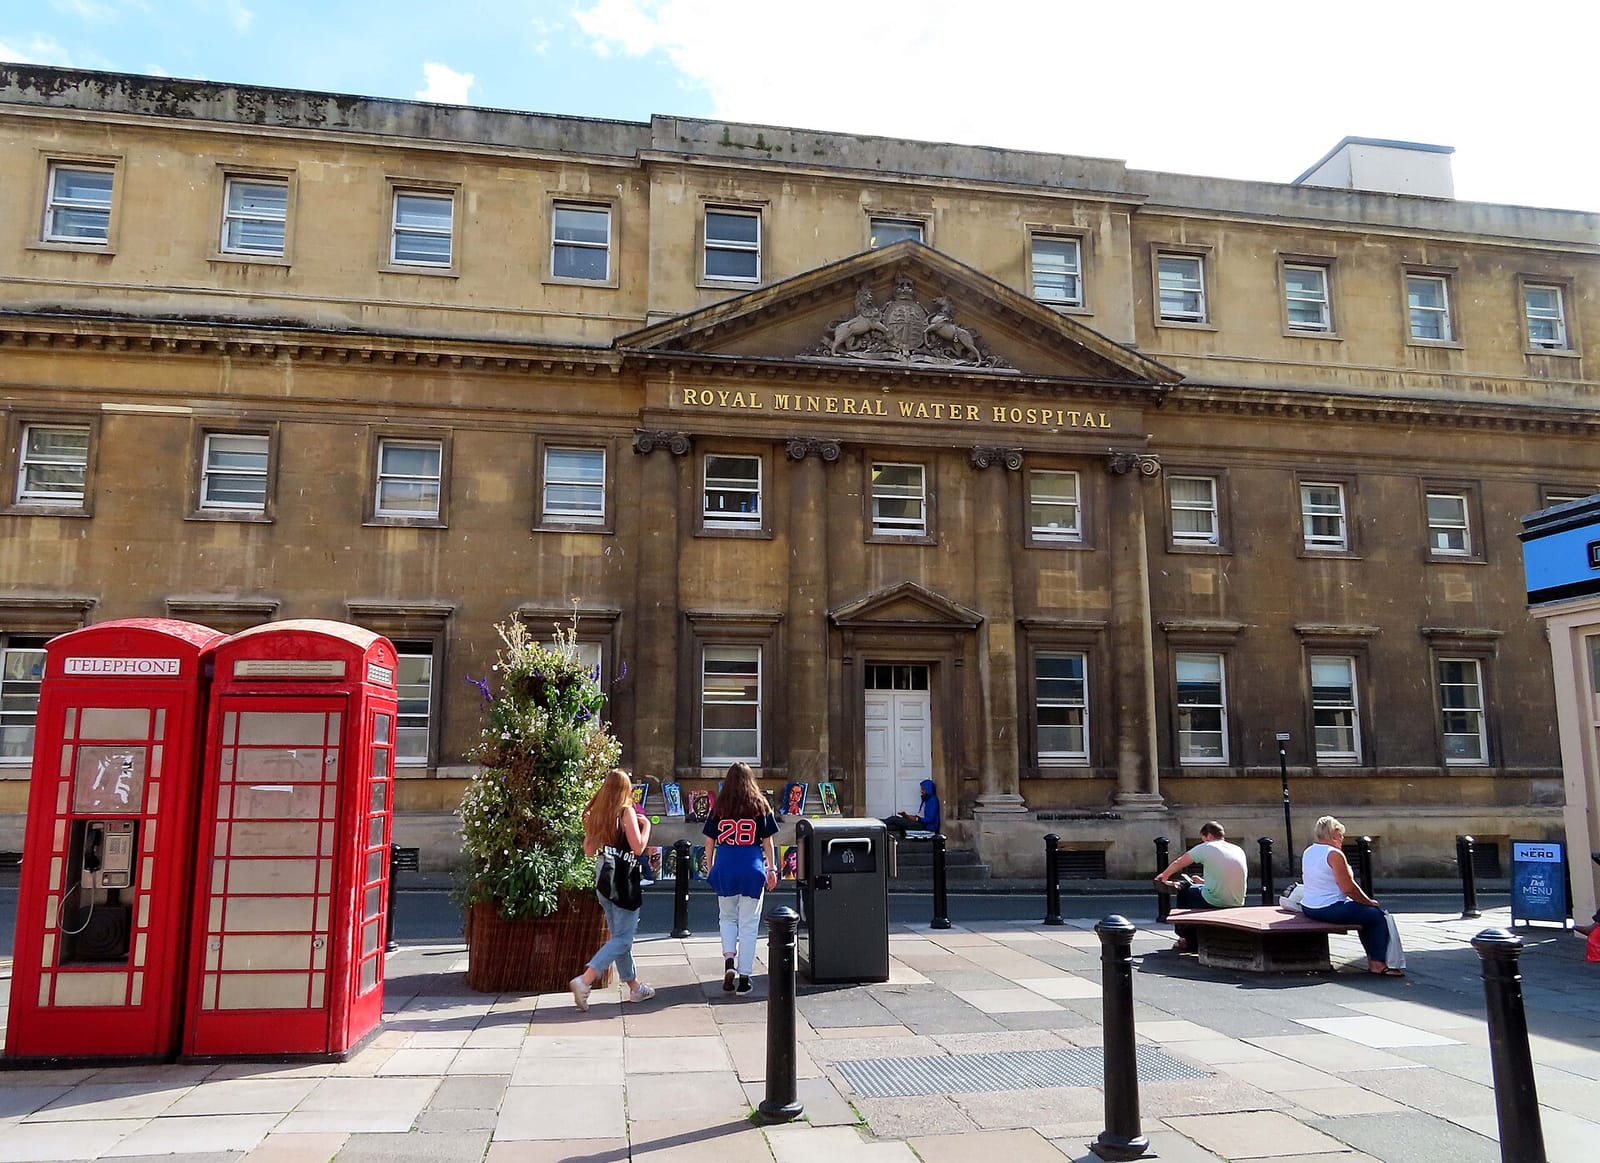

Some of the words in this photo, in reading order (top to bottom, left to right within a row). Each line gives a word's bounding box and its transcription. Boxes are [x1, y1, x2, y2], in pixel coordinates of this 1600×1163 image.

[683, 388, 763, 409] ROYAL
[774, 394, 889, 416] MINERAL
[898, 401, 980, 421] WATER
[992, 406, 1111, 428] HOSPITAL
[70, 659, 177, 673] TELEPHONE
[717, 818, 757, 846] 28
[1520, 851, 1554, 859] NERO
[1522, 886, 1553, 896] MENU
